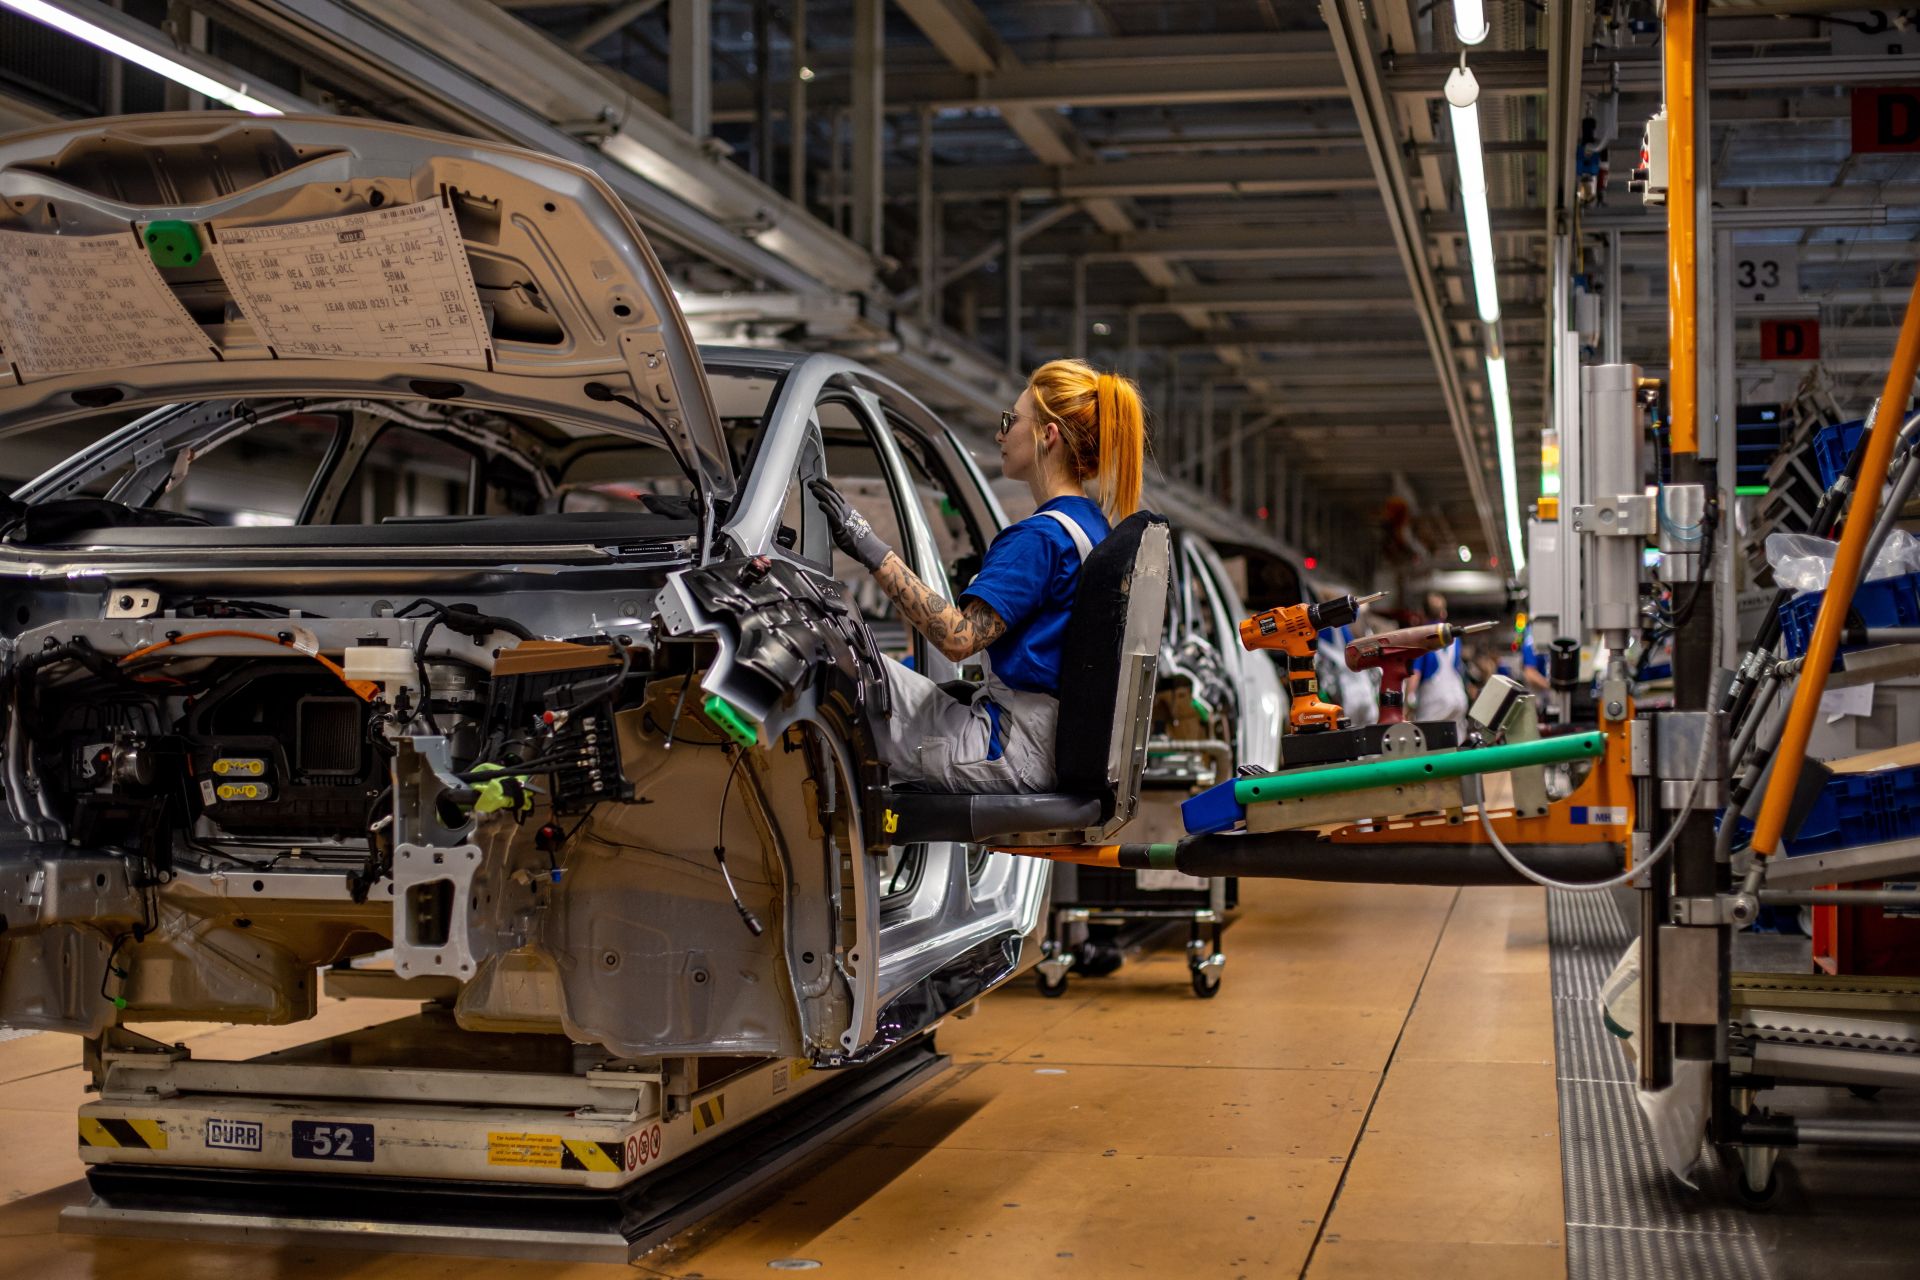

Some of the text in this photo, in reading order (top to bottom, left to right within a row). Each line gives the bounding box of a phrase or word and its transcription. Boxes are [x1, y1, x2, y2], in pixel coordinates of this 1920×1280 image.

[1878, 94, 1920, 145] D
[339, 231, 364, 242] Cupra
[1738, 260, 1780, 288] 33
[1776, 323, 1804, 355] D
[211, 1119, 257, 1146] DÜRR
[313, 1126, 354, 1157] 52
